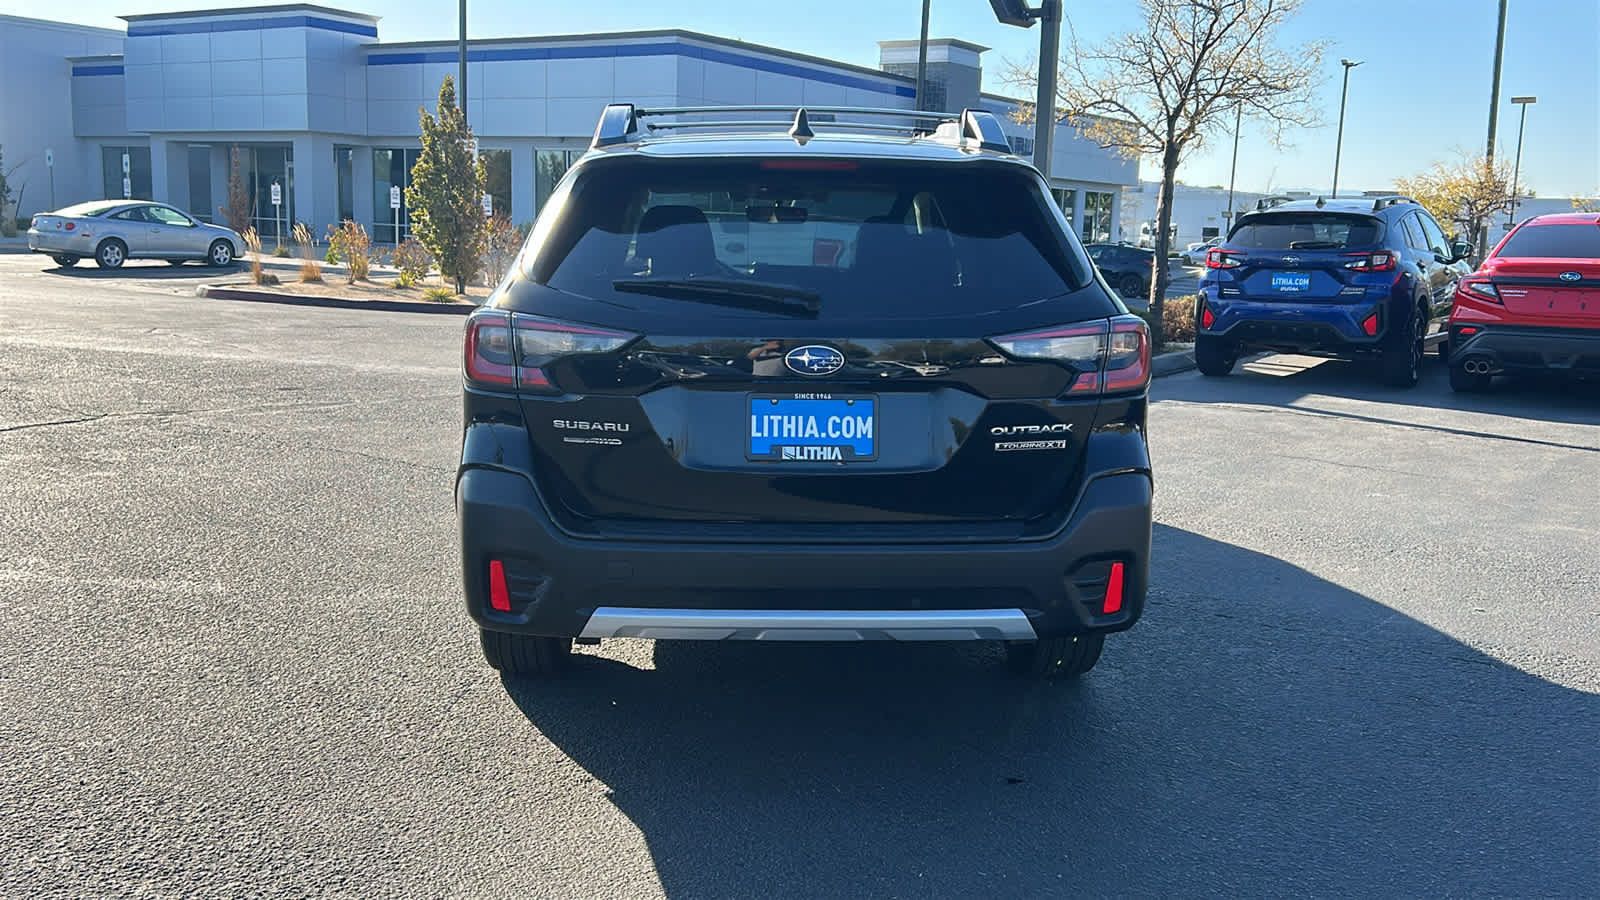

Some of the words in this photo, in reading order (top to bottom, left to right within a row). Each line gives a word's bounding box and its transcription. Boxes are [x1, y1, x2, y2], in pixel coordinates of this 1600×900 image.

[552, 418, 630, 432] SUBARU
[751, 414, 873, 439] LITHIA.COM
[990, 423, 1075, 436] OUTBACK
[1003, 441, 1046, 449] TOURING
[796, 446, 842, 460] LITHIA
